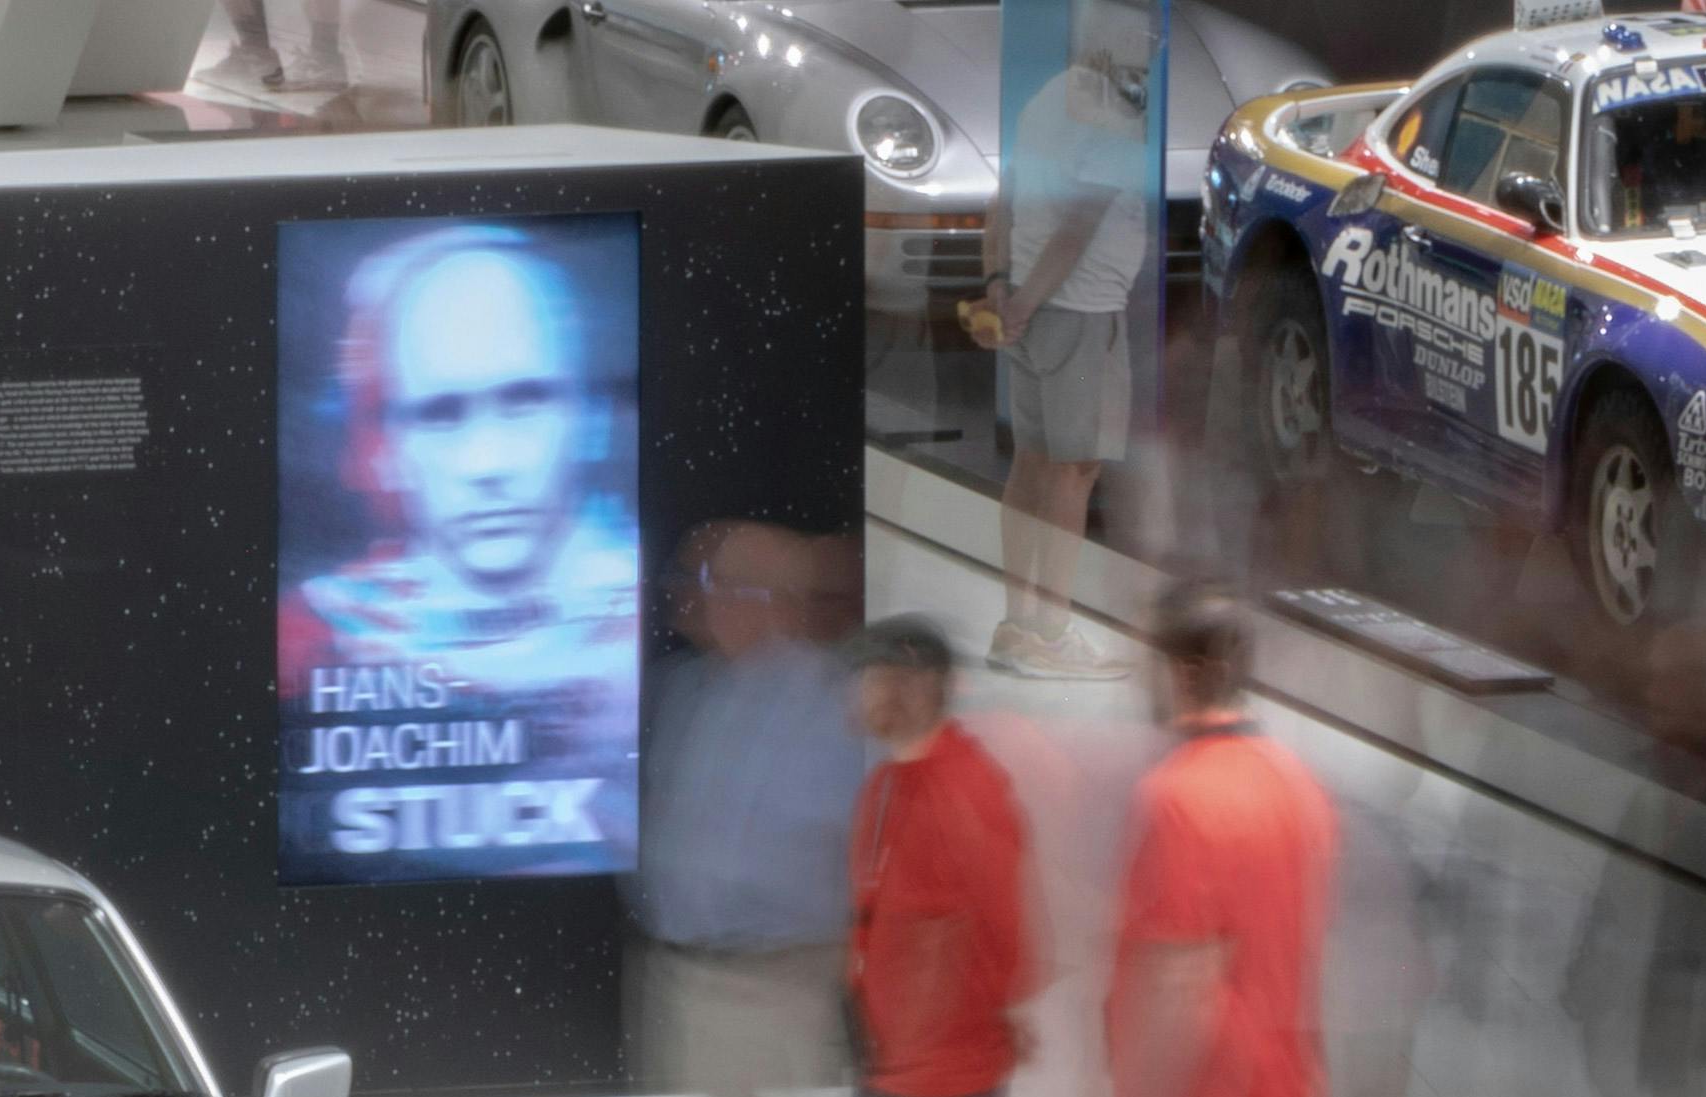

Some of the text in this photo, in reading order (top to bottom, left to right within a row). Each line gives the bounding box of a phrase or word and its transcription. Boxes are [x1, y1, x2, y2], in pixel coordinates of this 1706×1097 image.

[1321, 226, 1496, 341] Rothmans
[1342, 295, 1485, 366] PORSCHE
[1413, 344, 1485, 390] DUNLOP
[1499, 326, 1558, 438] 185
[310, 662, 470, 714] HANS-
[299, 720, 524, 774] JOACHIM
[331, 779, 604, 853] STUCK
